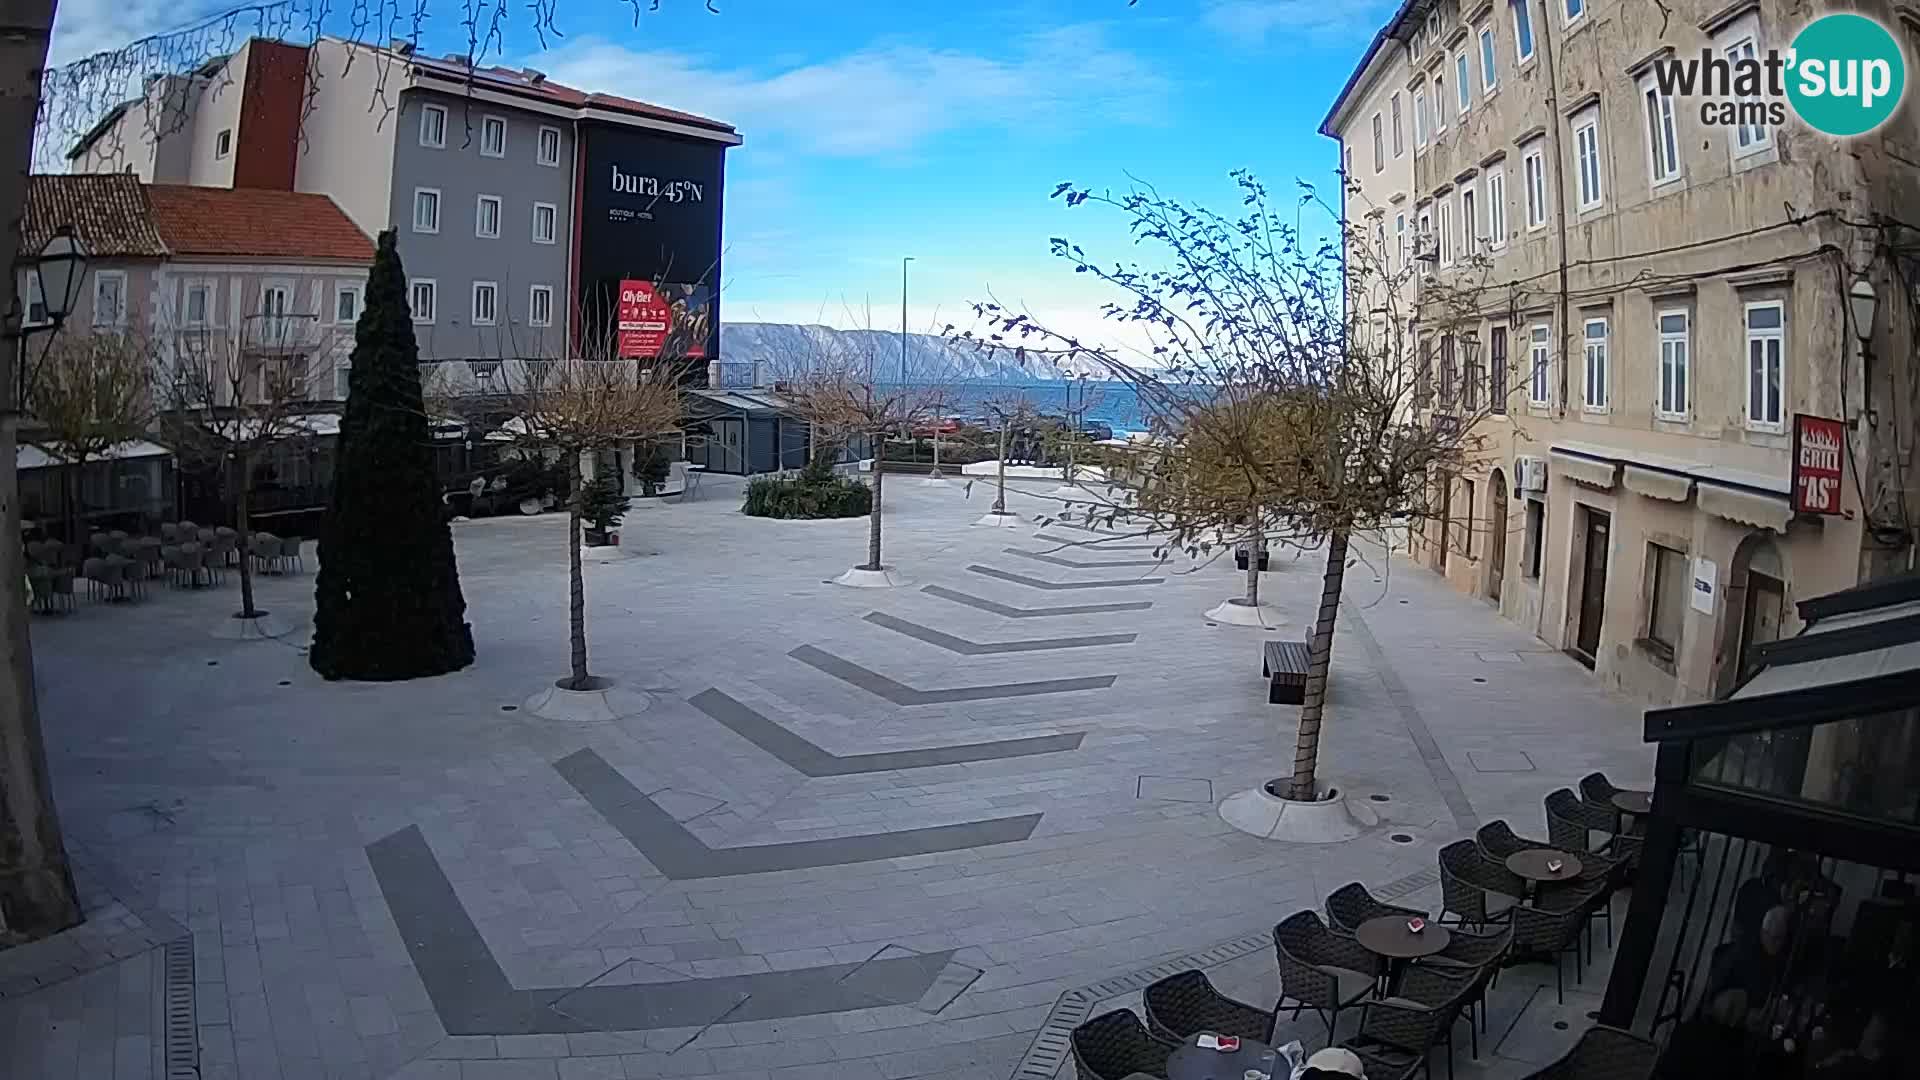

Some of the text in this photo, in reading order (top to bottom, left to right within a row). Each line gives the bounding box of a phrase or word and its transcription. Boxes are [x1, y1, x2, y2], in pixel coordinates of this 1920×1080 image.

[612, 165, 658, 196] bura
[622, 290, 652, 306] OlyBet
[1800, 447, 1840, 472] GRILL
